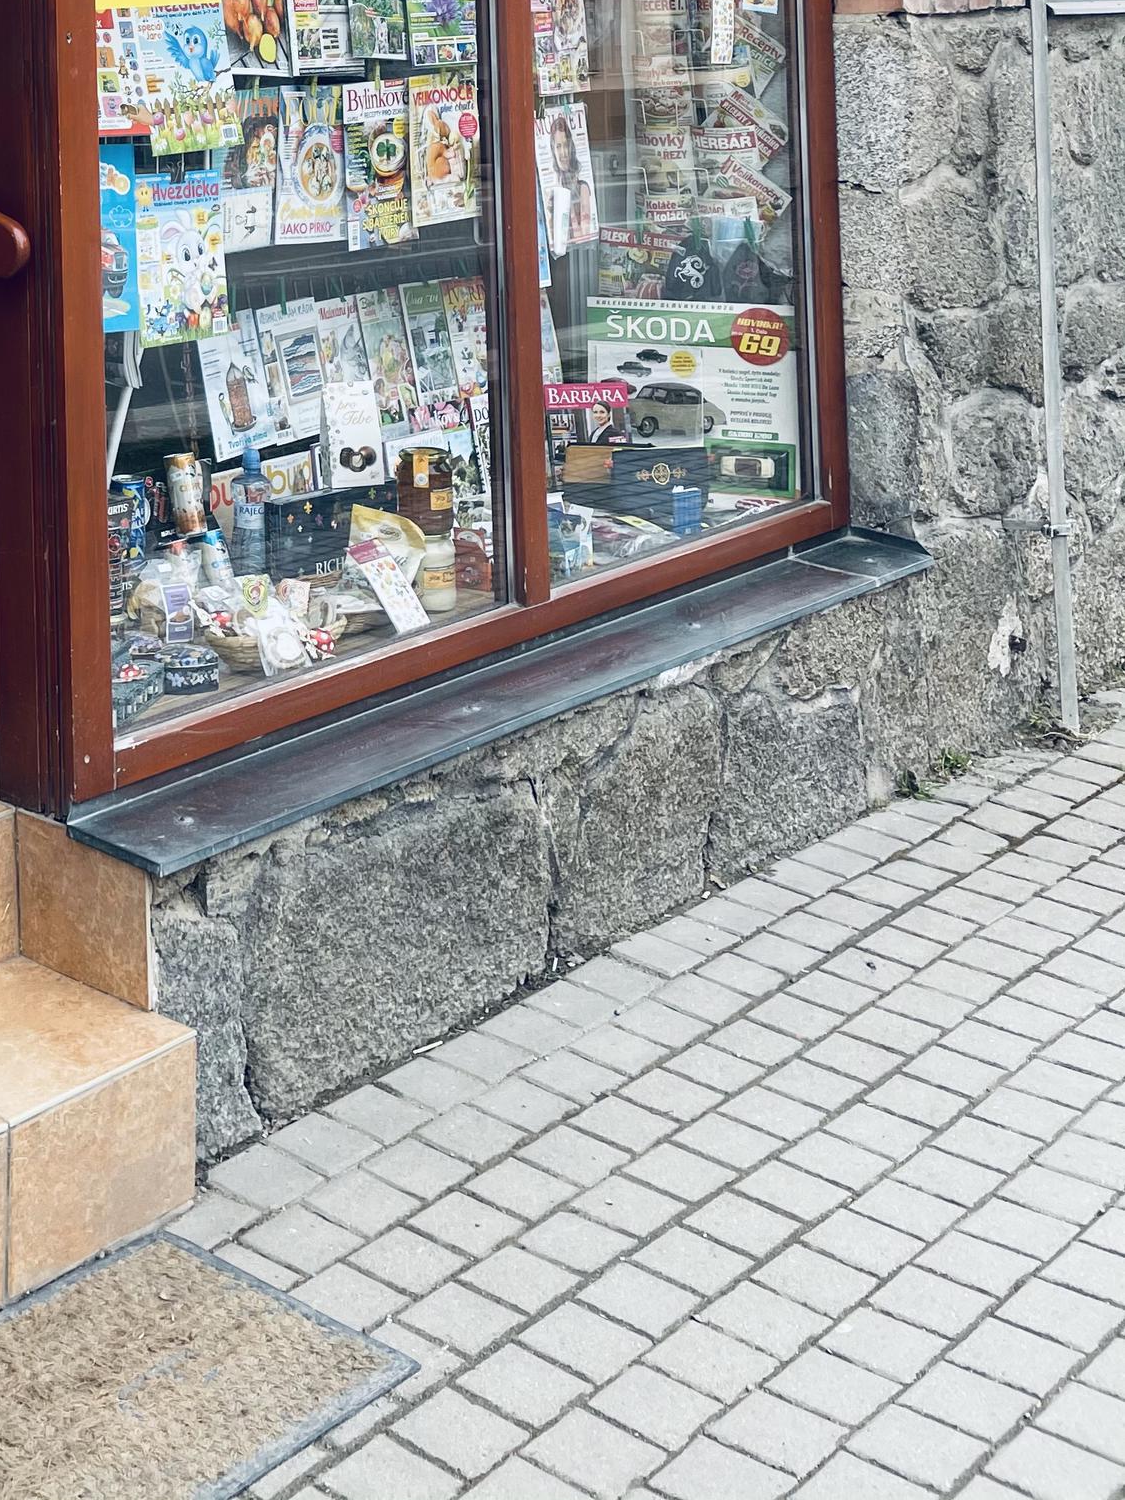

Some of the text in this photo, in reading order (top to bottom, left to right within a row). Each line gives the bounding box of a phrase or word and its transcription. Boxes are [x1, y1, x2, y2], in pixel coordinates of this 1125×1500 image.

[412, 84, 474, 107] VELIKONOCE
[693, 131, 752, 150] HERBÁŘ
[281, 220, 309, 235] JAKO
[601, 229, 630, 243] BLESK
[607, 309, 716, 343] ŠKODA
[738, 333, 781, 357] 69
[548, 387, 625, 405] BARBARA
[239, 504, 266, 517] RAJEC
